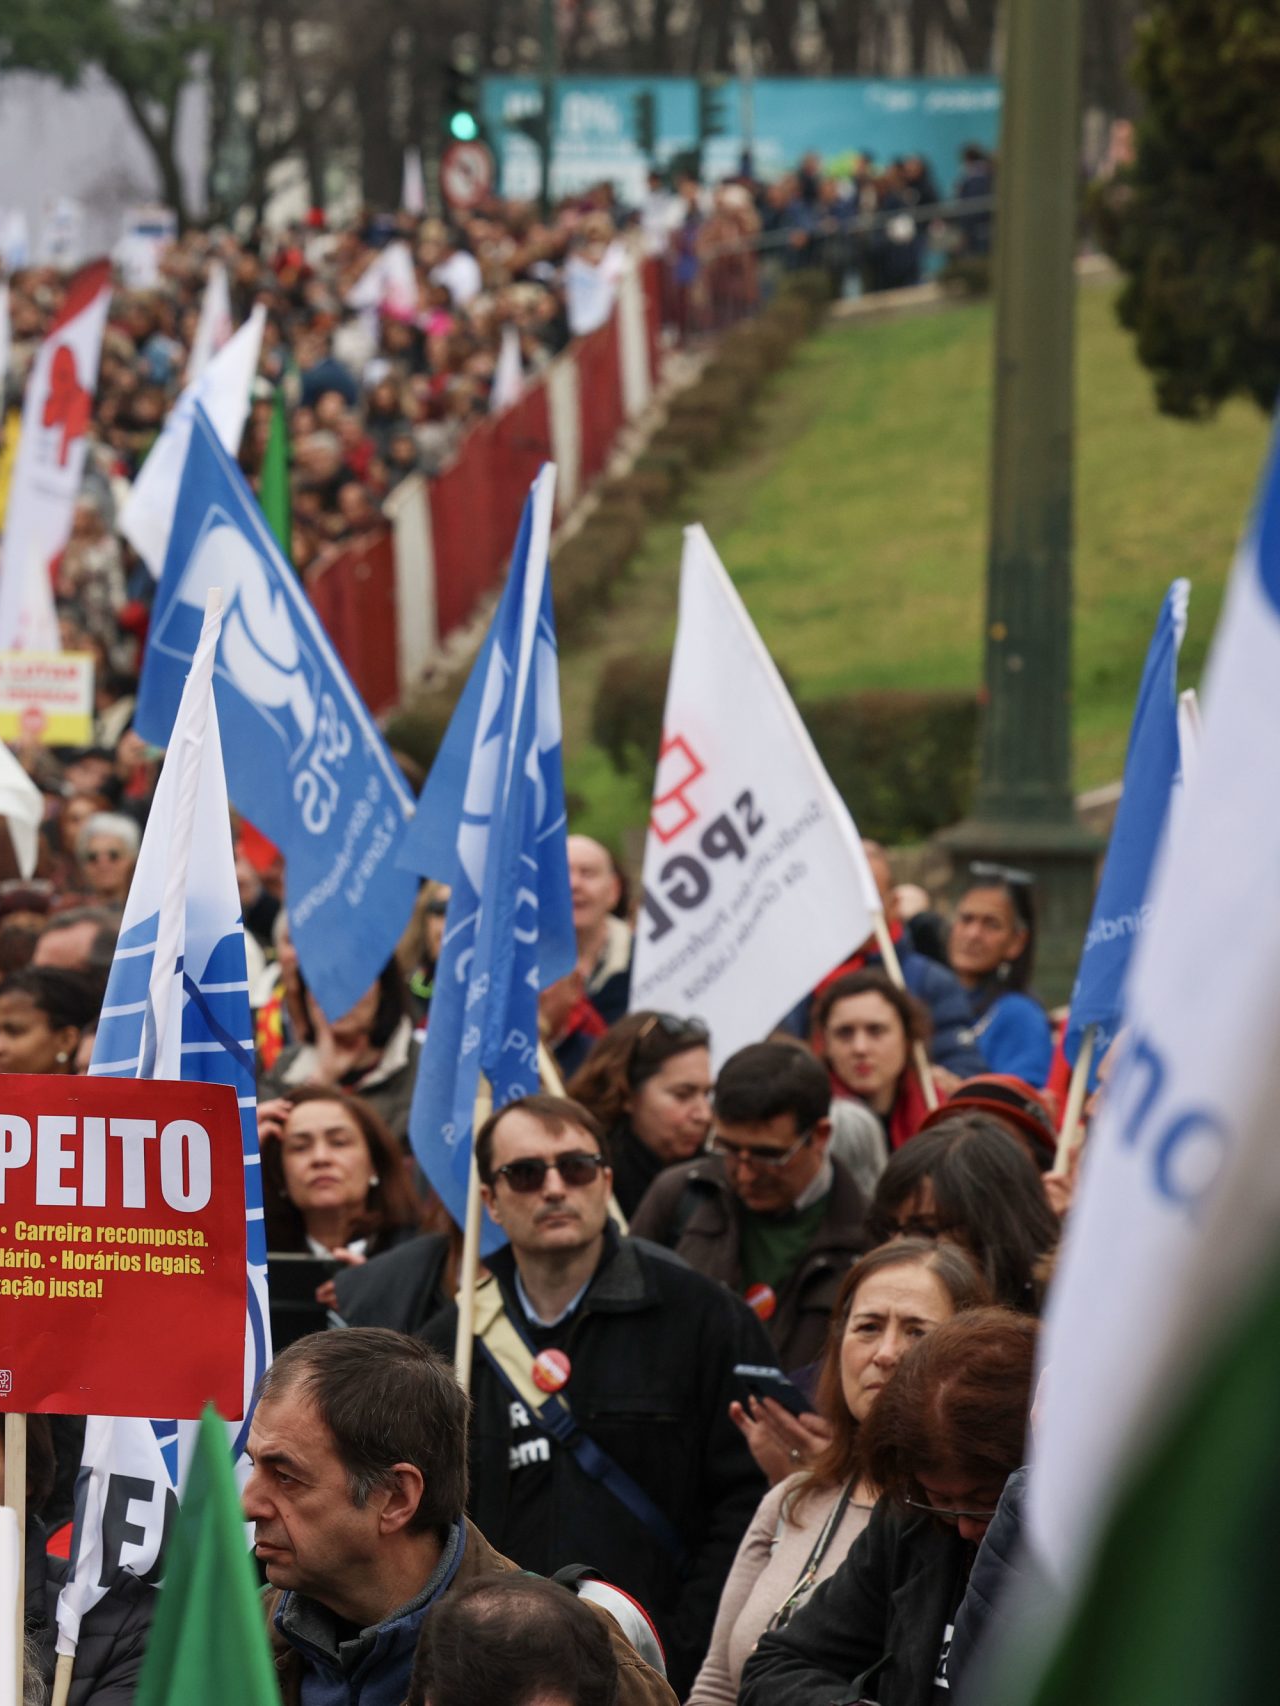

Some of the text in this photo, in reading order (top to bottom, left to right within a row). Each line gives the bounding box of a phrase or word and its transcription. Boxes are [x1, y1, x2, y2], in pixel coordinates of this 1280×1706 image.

[14, 1220, 92, 1243] Carreira
[96, 1226, 209, 1248] recomposta.
[61, 1250, 141, 1273] Horários
[145, 1253, 205, 1276] legais.
[48, 1277, 103, 1299] justa!
